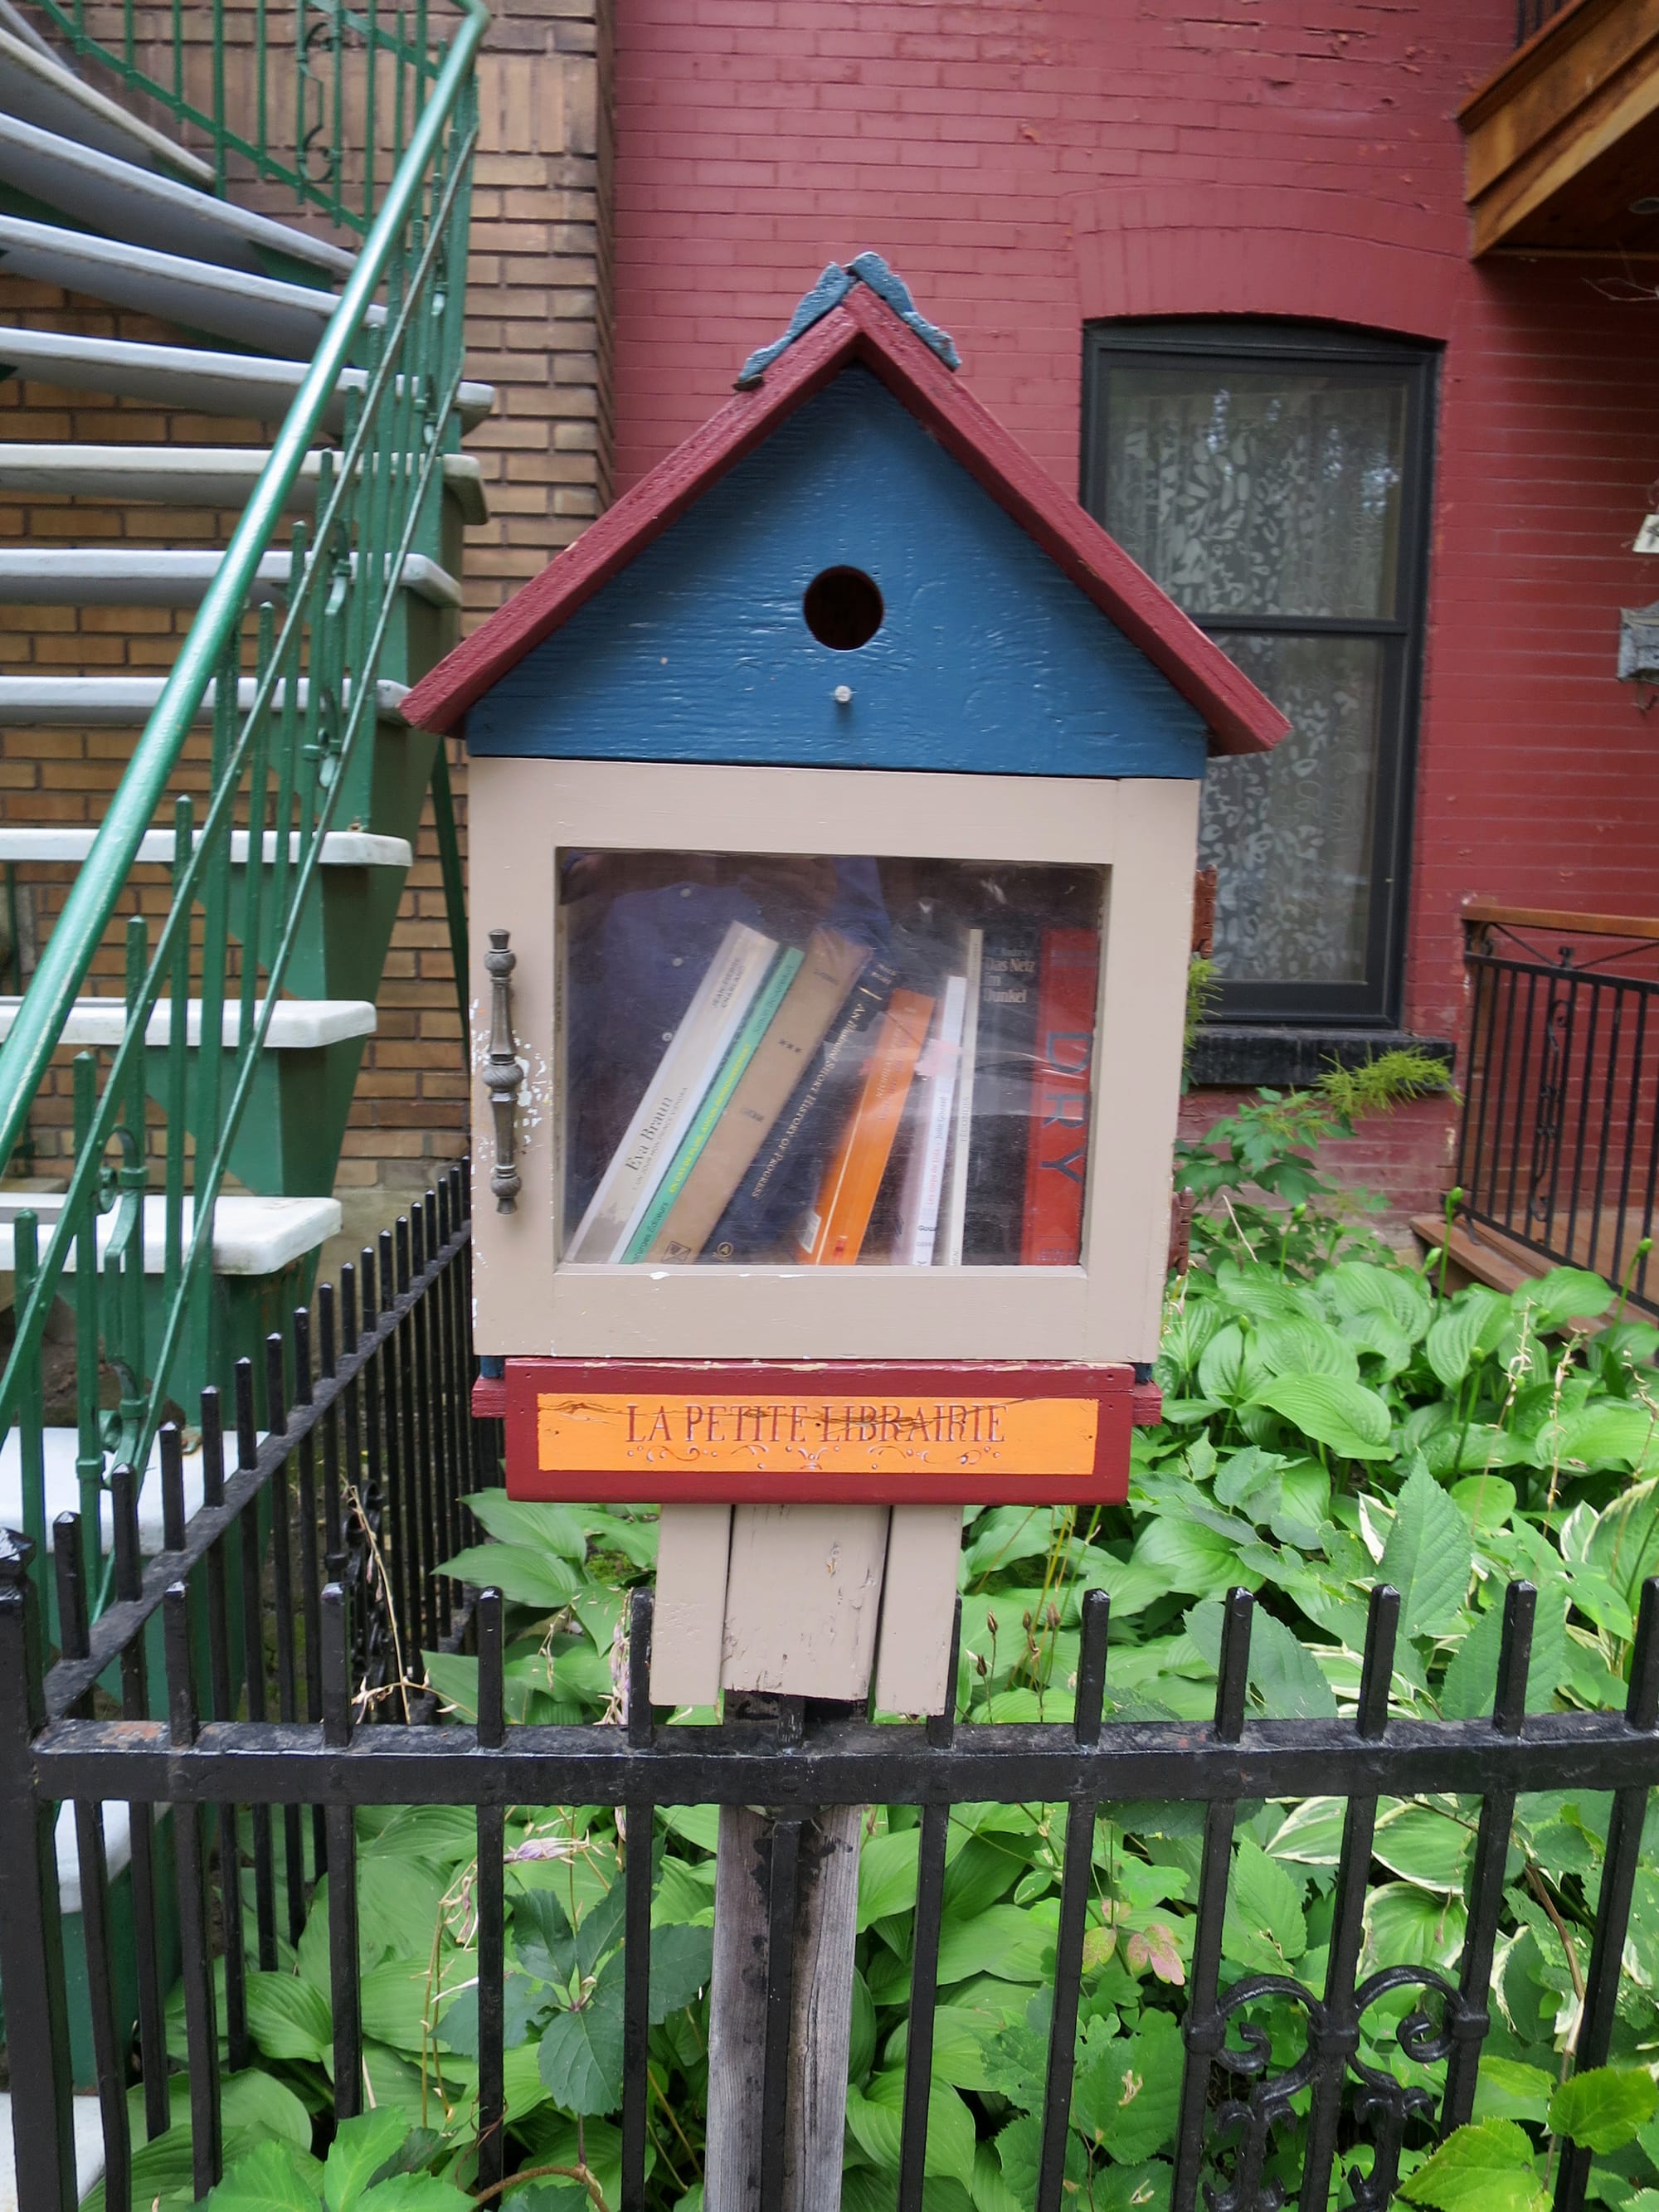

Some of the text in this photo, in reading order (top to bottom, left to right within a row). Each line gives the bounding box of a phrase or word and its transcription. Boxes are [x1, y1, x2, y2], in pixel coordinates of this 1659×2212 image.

[1010, 958, 1035, 972] Netz
[624, 1092, 673, 1171] Eva Braun
[1039, 1031, 1093, 1184] DRY
[625, 1404, 1007, 1442] LA PETITE LIBRAIRIE
